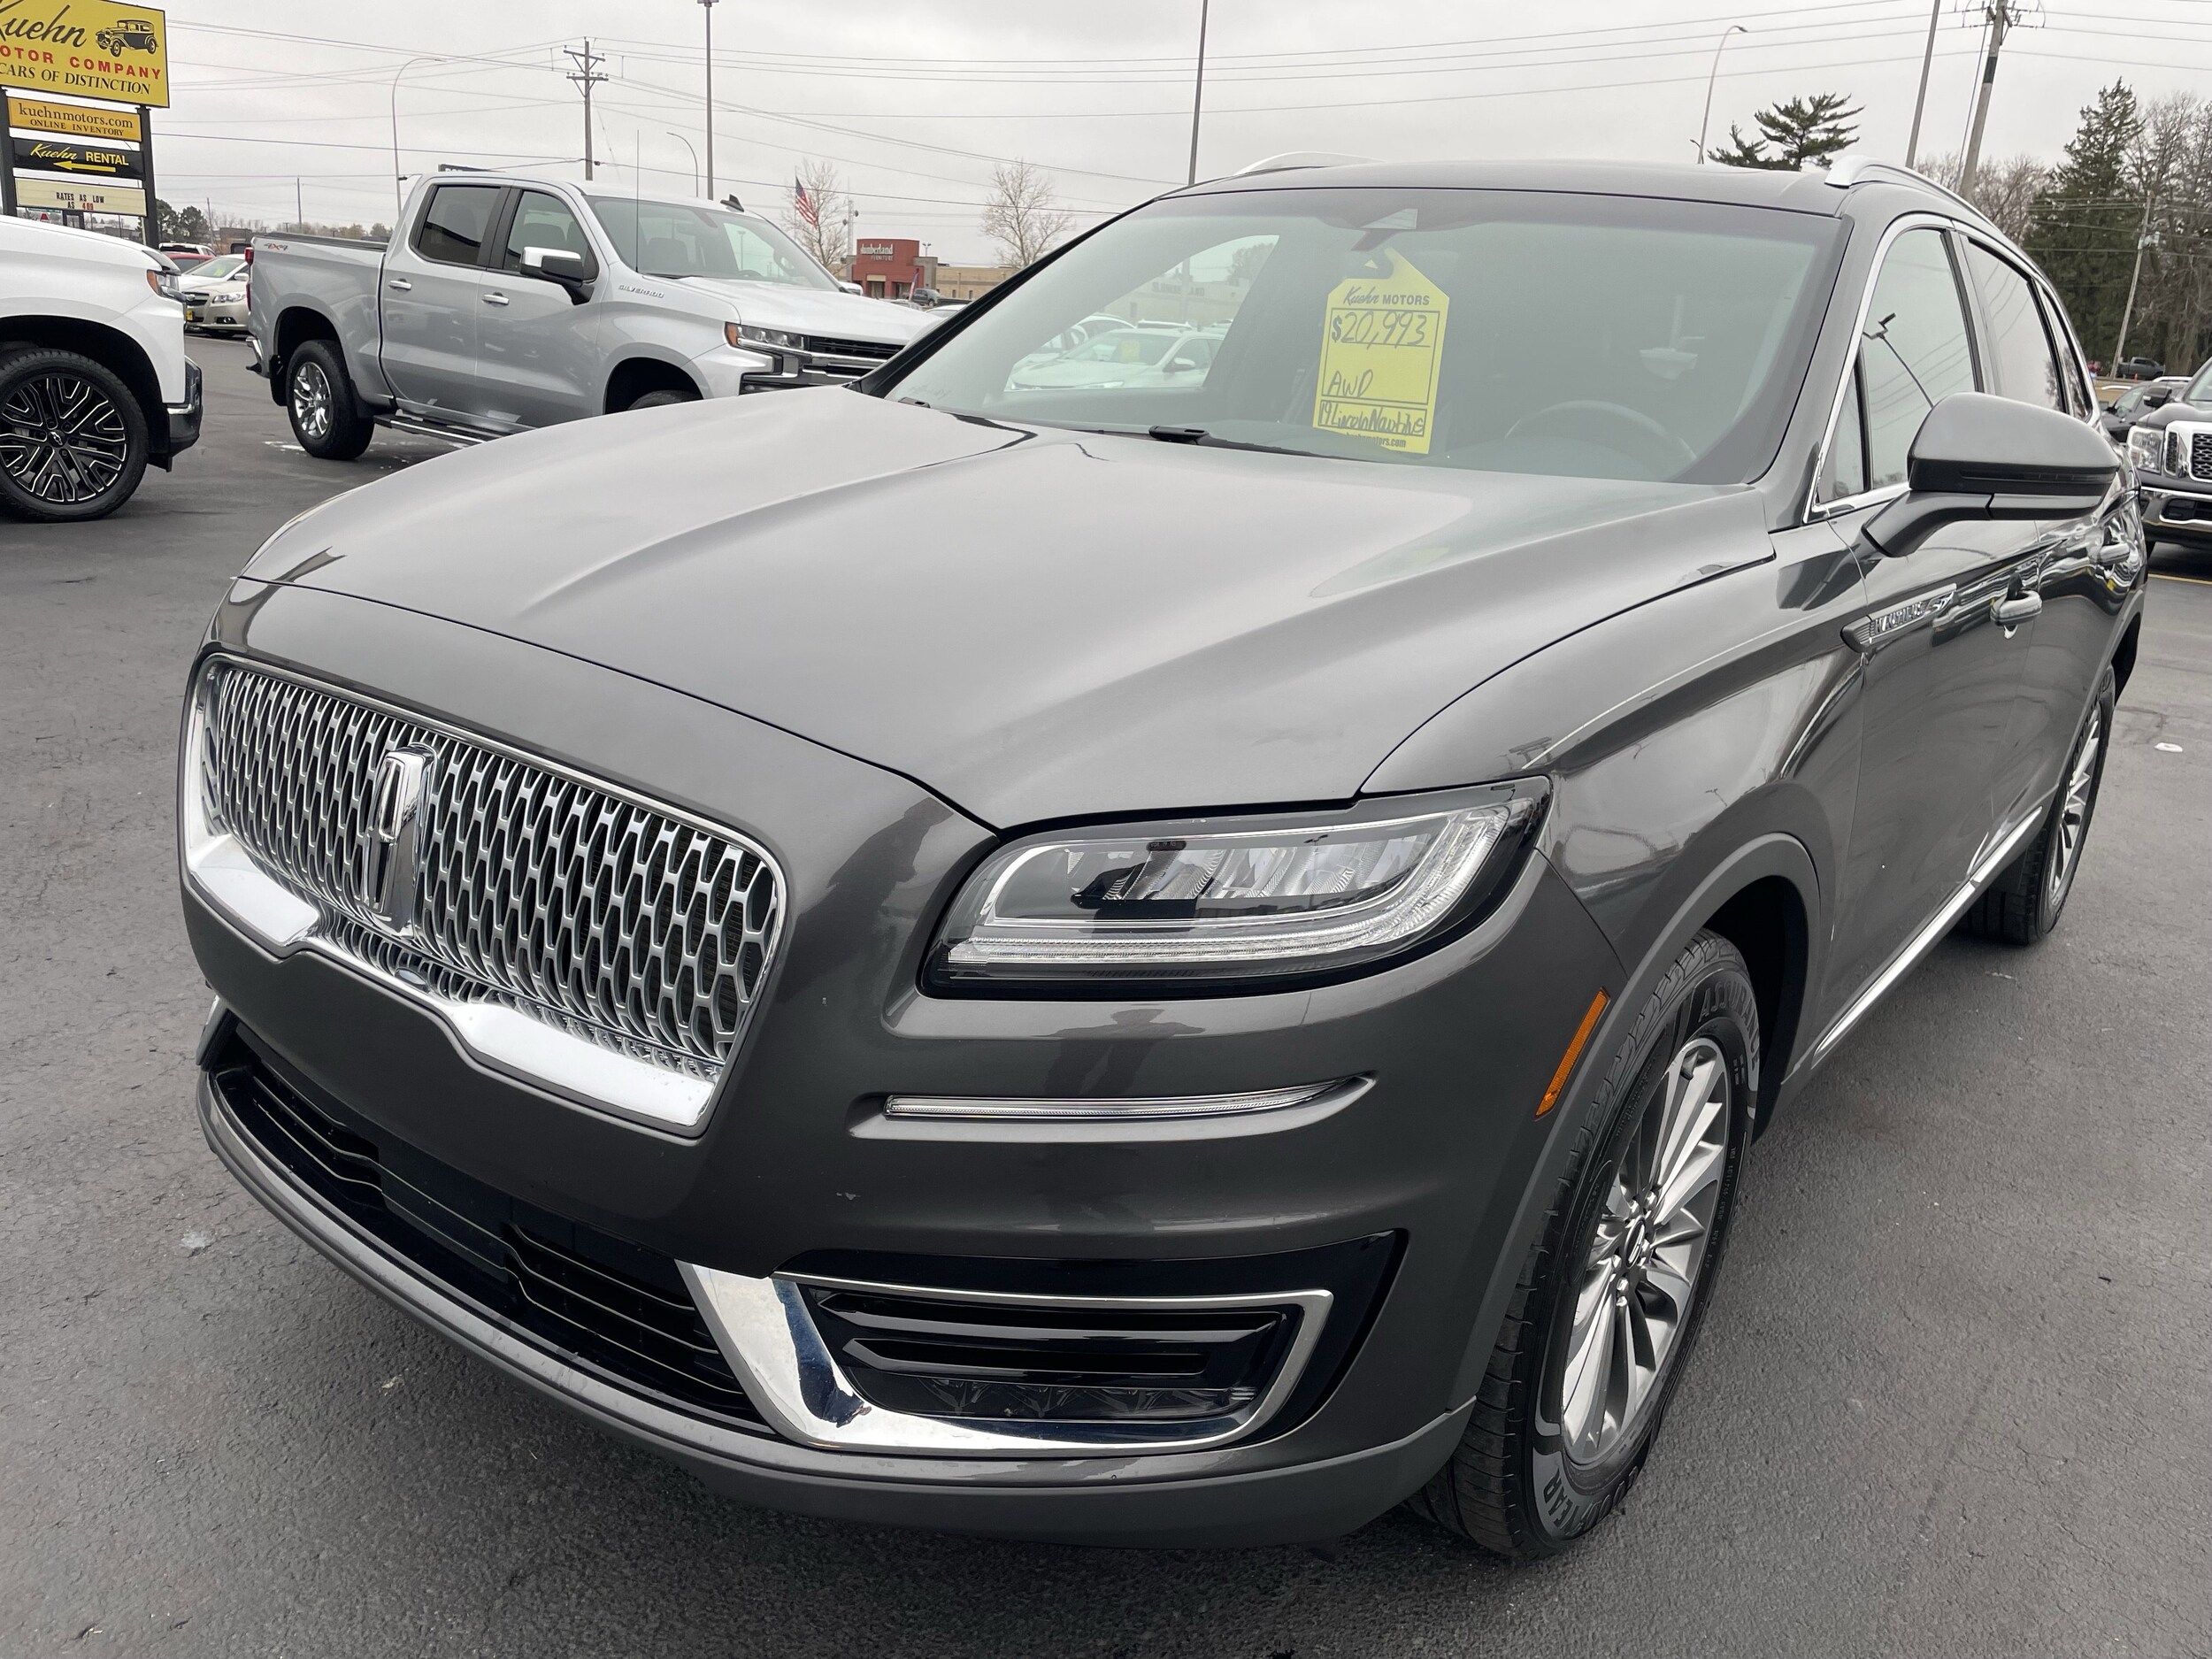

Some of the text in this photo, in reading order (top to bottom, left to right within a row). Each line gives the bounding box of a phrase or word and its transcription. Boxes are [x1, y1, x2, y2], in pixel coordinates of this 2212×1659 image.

[0, 62, 150, 95] CARS OF DISTINCTION
[69, 57, 161, 80] COMPANY
[19, 103, 134, 129] kuehnmotors.com
[30, 119, 124, 136] ONLINE INVENTORY
[30, 142, 129, 165] Kuehn RENTAL
[56, 191, 104, 204] RATES AS LOW
[67, 201, 75, 210] AS
[1343, 285, 1430, 306] Kuehn MOTORS
[1327, 368, 1374, 398] AWD
